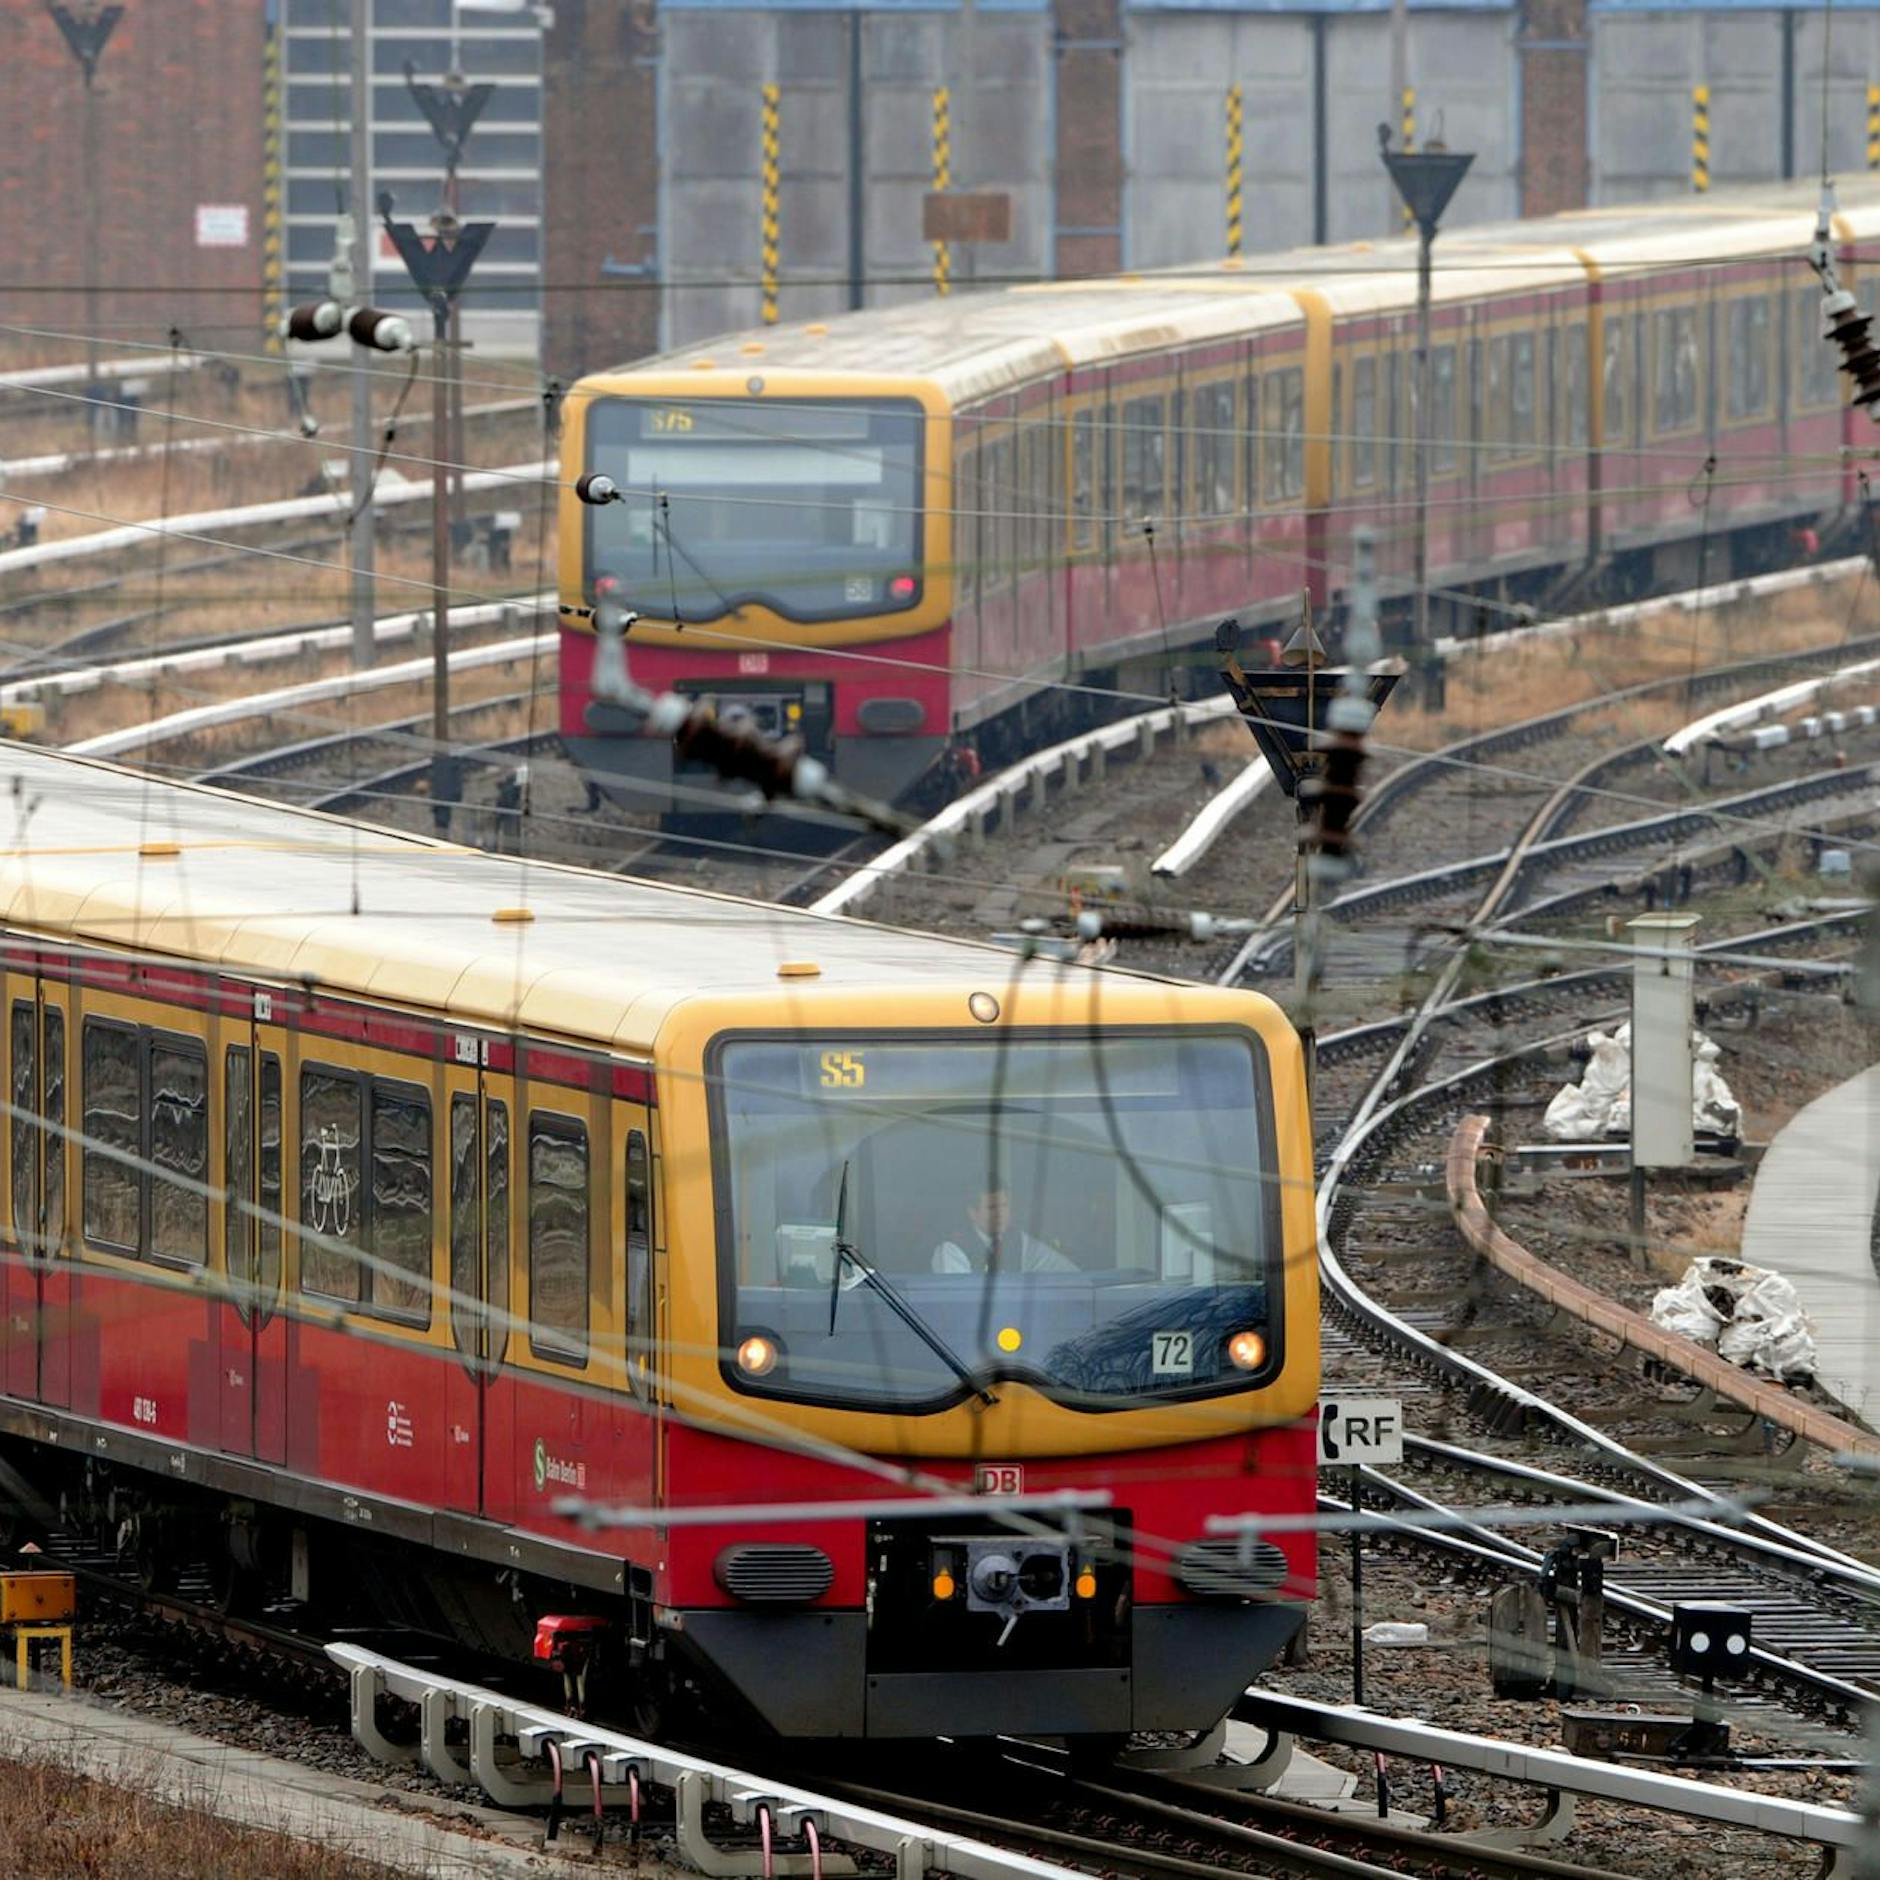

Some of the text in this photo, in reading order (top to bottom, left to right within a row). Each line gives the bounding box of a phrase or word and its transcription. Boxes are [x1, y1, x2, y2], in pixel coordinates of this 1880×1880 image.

[820, 1050, 865, 1088] S5
[1156, 1335, 1188, 1366] 72
[1345, 1416, 1395, 1447] RF
[982, 1470, 1017, 1493] DB
